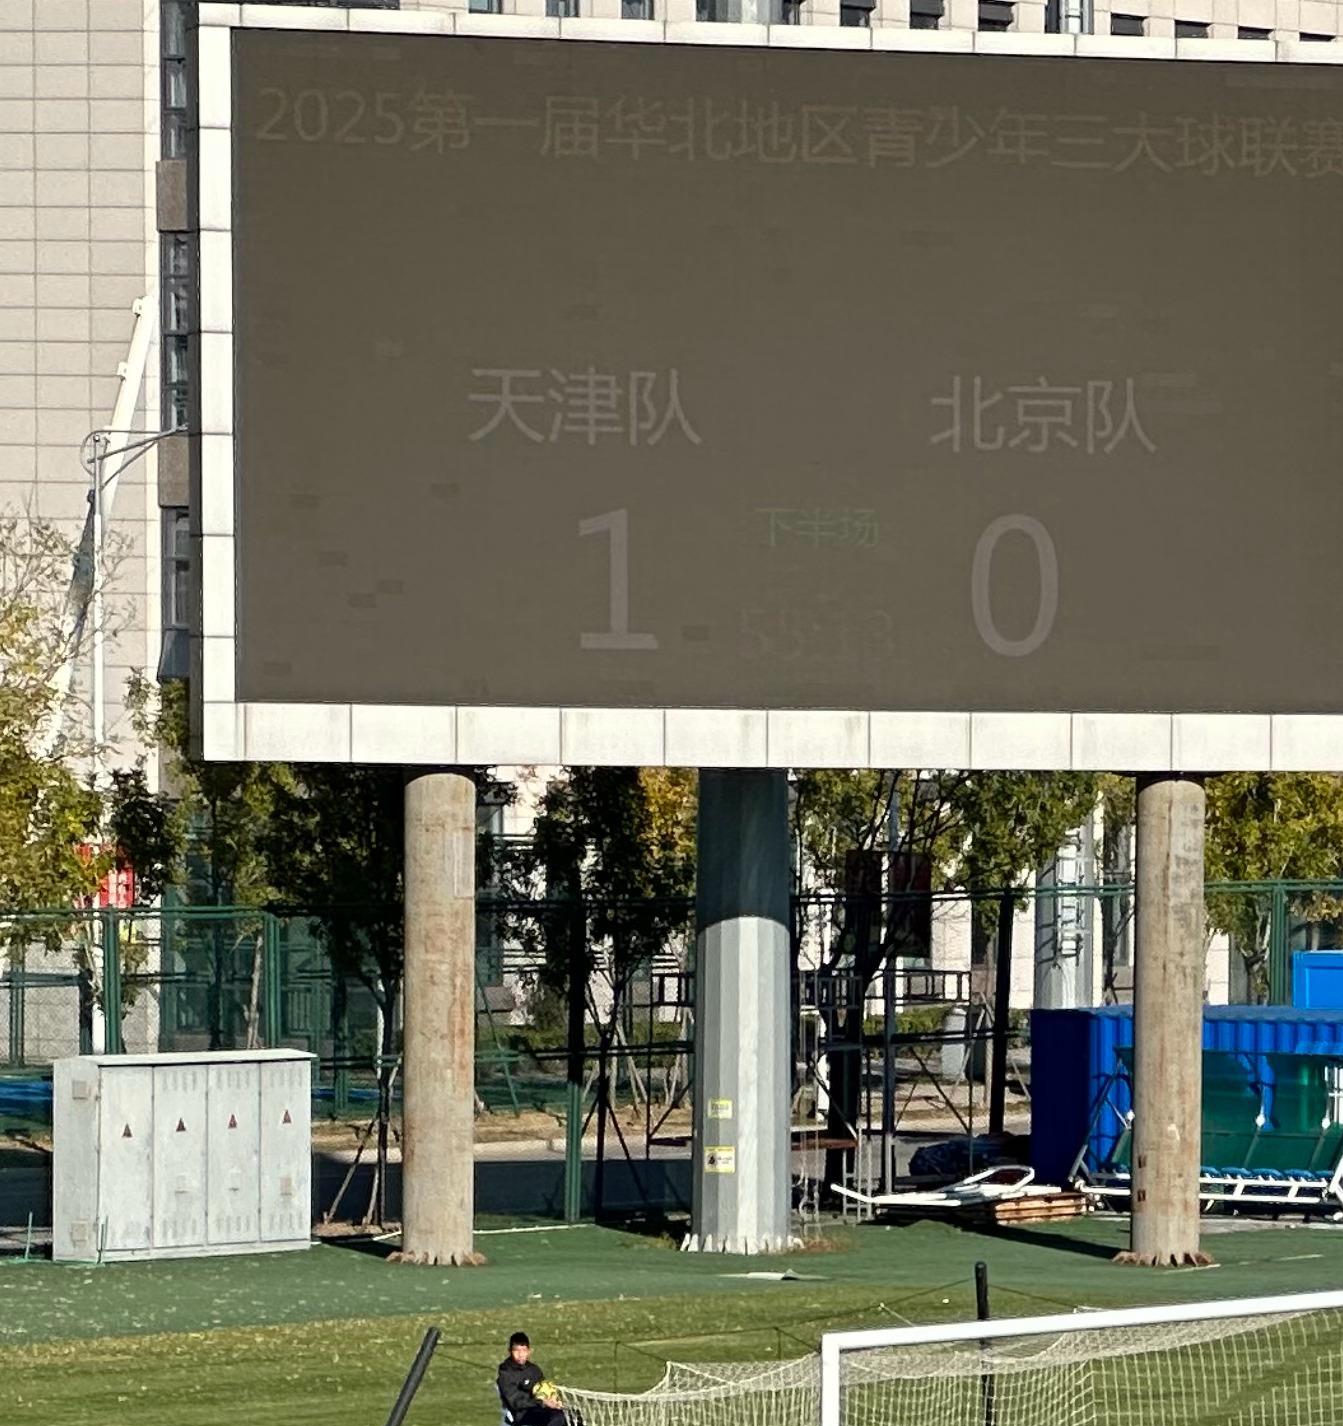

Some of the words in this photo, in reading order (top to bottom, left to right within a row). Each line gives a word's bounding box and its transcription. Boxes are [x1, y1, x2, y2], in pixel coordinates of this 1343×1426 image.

[467, 367, 702, 447] 天津队
[929, 375, 1156, 455] 北京队
[754, 506, 879, 549] 下半场
[577, 507, 660, 652] 1
[970, 513, 1060, 658] 0
